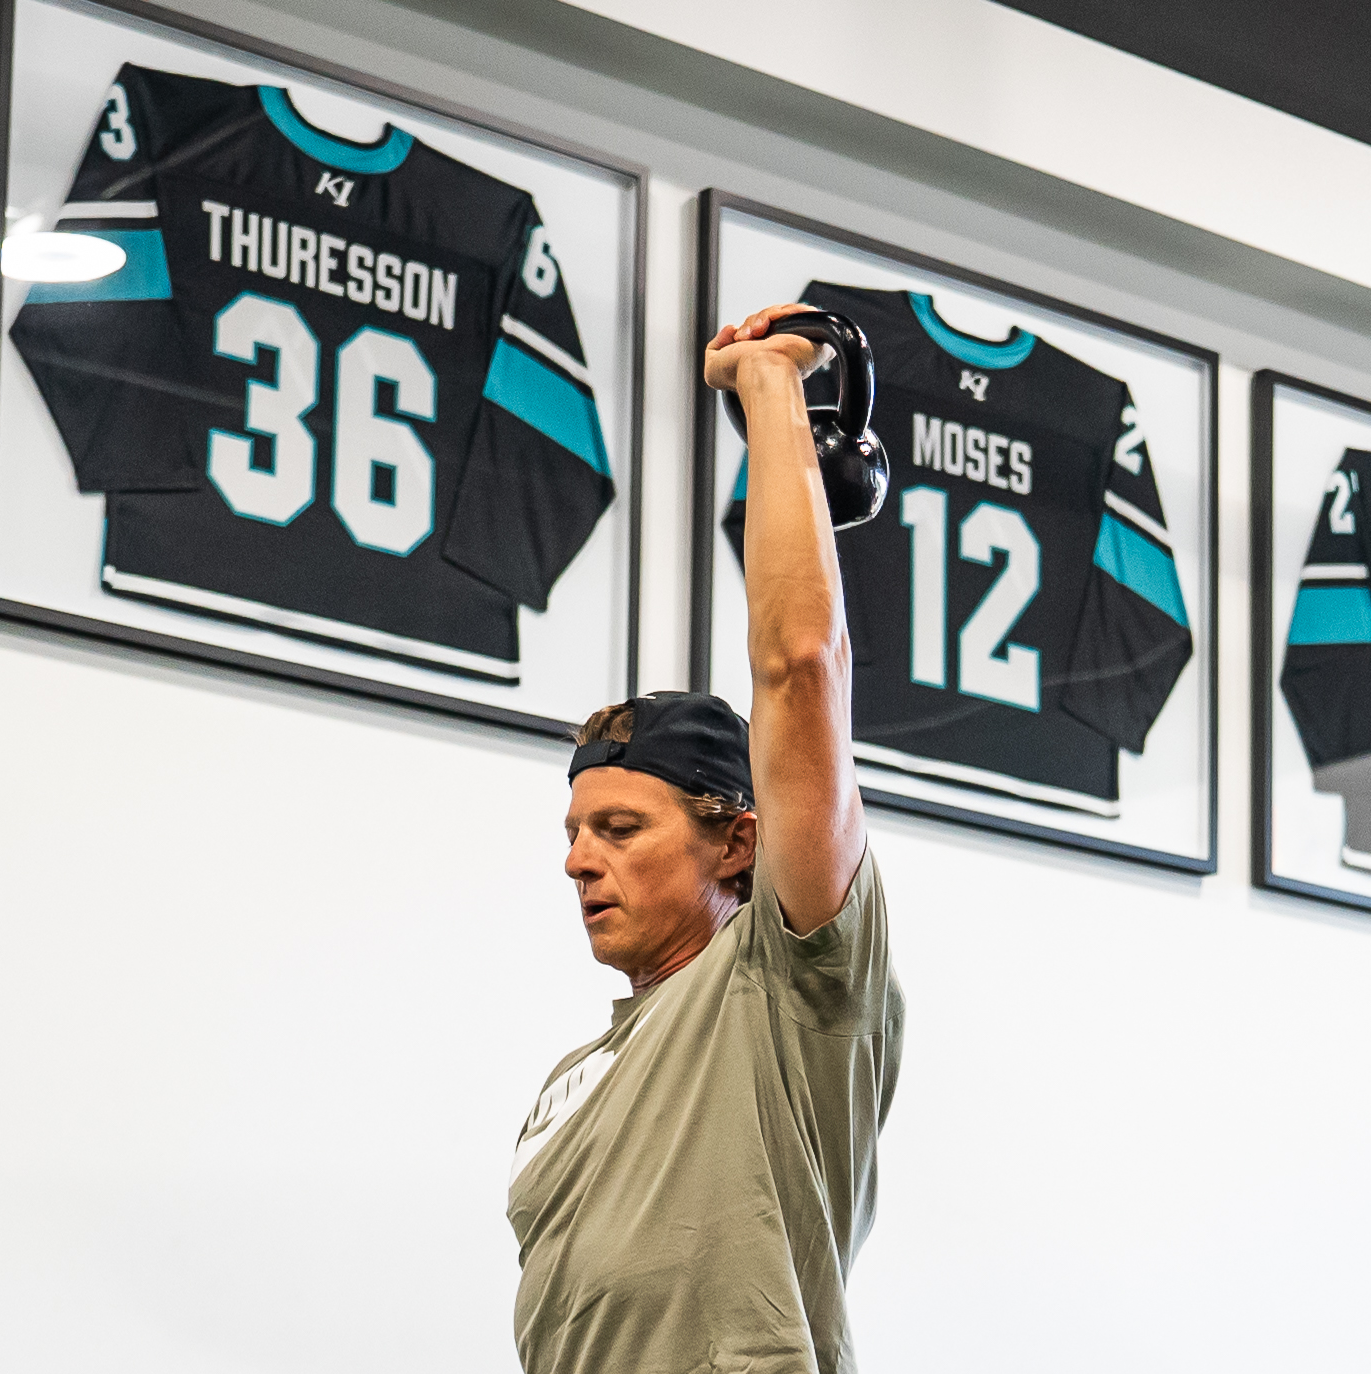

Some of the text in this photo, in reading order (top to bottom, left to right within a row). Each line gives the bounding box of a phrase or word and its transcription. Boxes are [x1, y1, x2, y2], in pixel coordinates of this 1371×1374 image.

[201, 200, 458, 331] THURESSON
[205, 290, 437, 558] 36
[912, 412, 1033, 495] MOSES
[900, 484, 1042, 713] 12
